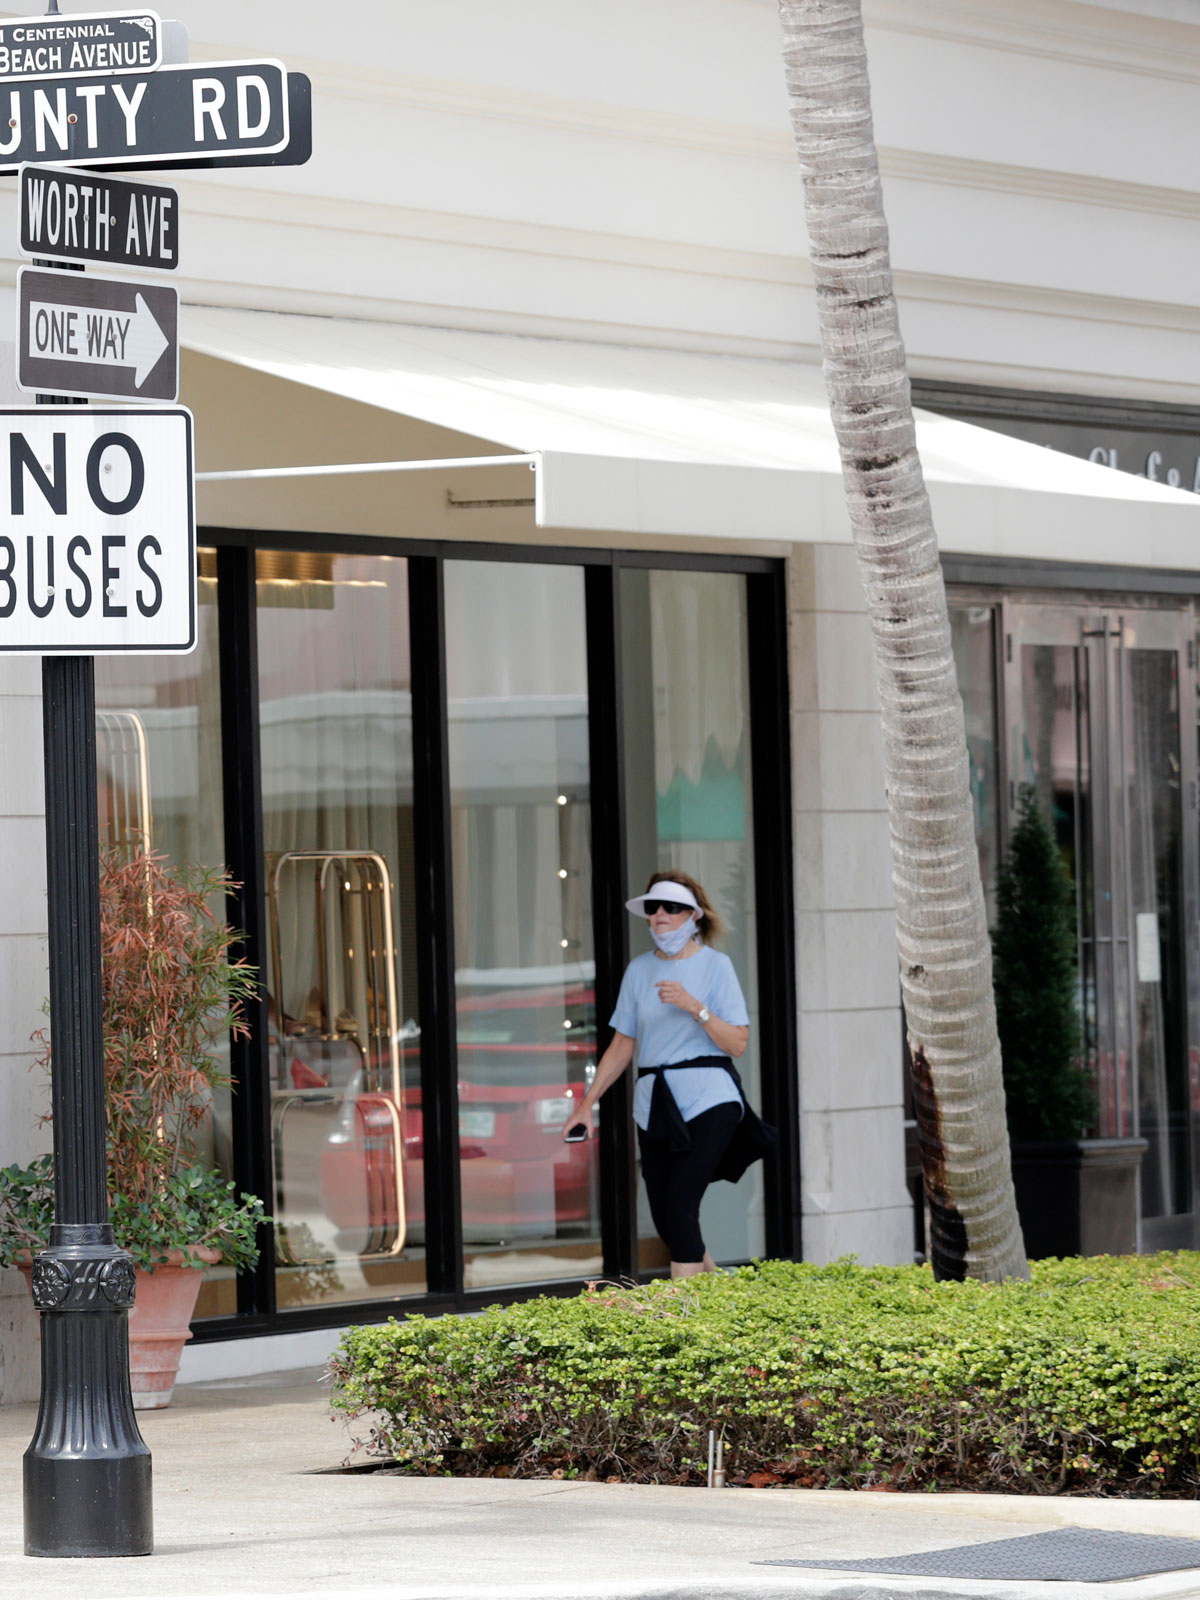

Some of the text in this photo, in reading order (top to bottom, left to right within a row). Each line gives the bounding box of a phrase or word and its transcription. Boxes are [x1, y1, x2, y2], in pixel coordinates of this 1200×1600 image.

[12, 24, 115, 43] CENTENNIAL
[69, 40, 151, 69] AVENUE
[192, 74, 272, 143] RD
[27, 176, 173, 260] WORTH AVE
[34, 308, 131, 361] ONE WAY
[9, 431, 145, 516] NO
